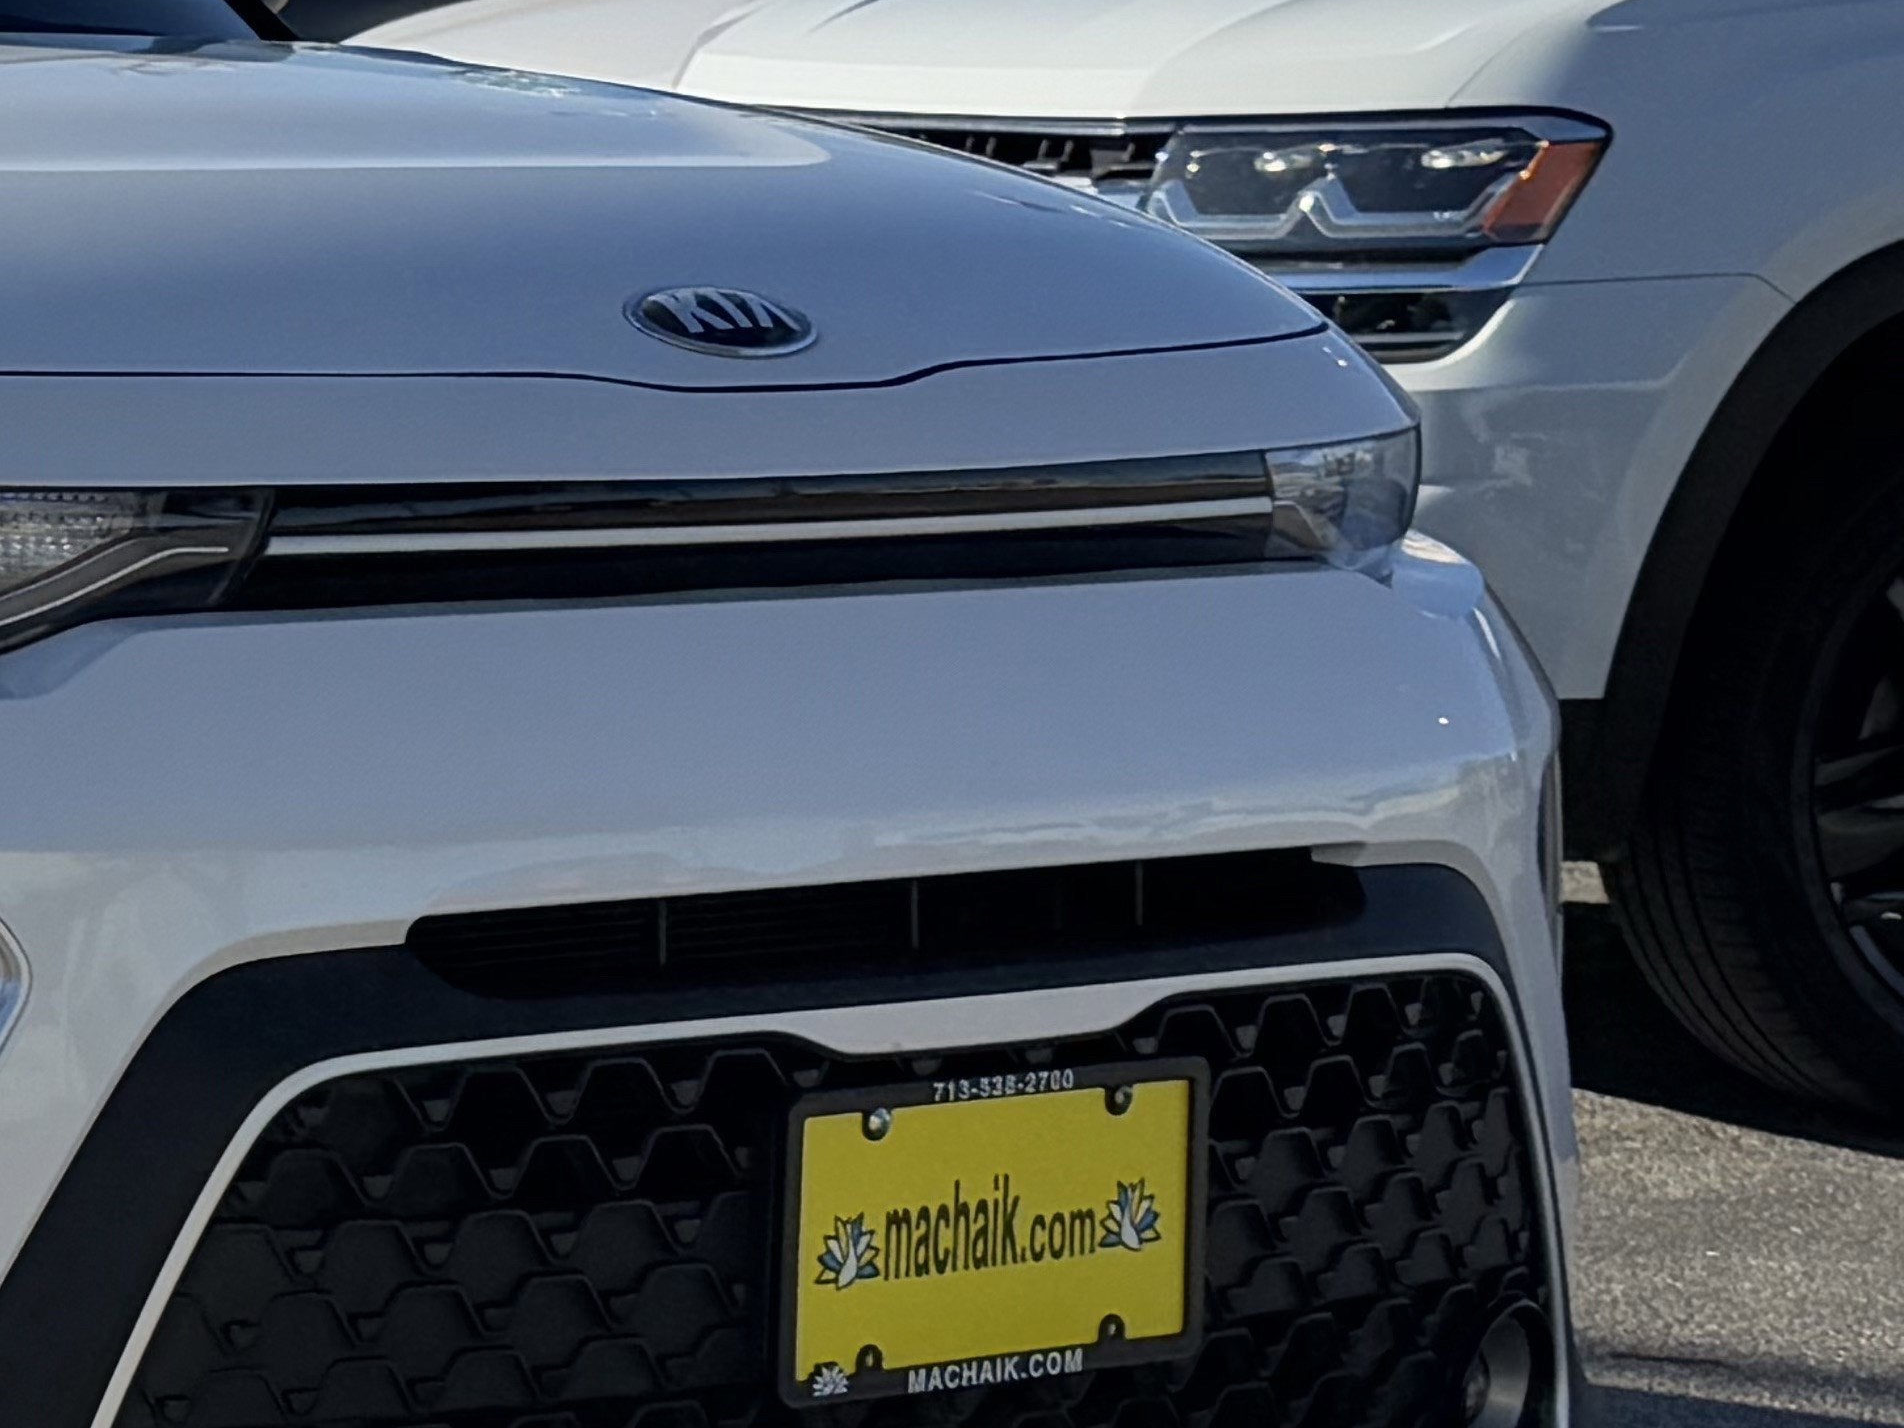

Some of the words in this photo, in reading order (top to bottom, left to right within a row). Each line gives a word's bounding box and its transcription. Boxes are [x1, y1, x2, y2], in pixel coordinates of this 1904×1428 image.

[645, 286, 802, 334] KIA
[883, 1173, 1096, 1281] machaik.com
[907, 1348, 1083, 1394] MACHAIK.COM
